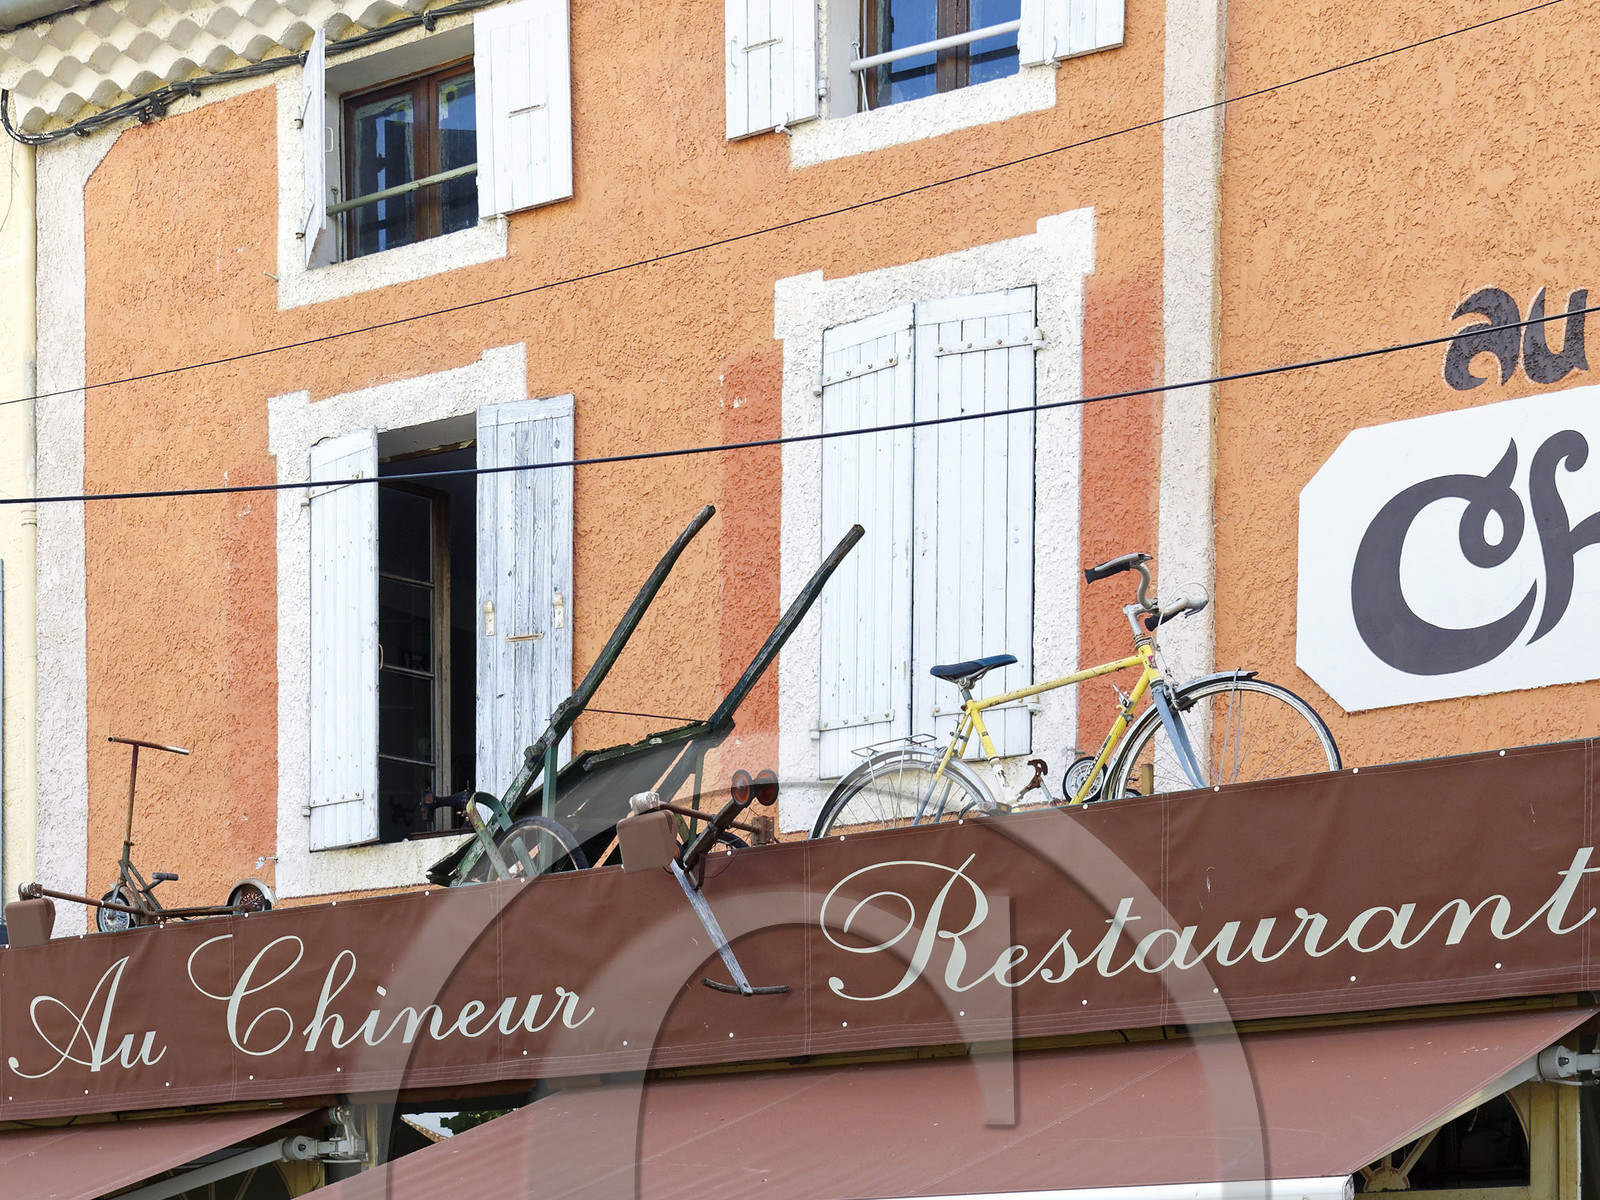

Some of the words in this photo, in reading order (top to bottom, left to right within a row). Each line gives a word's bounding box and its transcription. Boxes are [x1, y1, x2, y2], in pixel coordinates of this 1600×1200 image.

[1442, 284, 1590, 391] au
[8, 955, 167, 1079] Au
[187, 934, 595, 1057] Chineur
[820, 845, 1599, 1001] Restaurant
